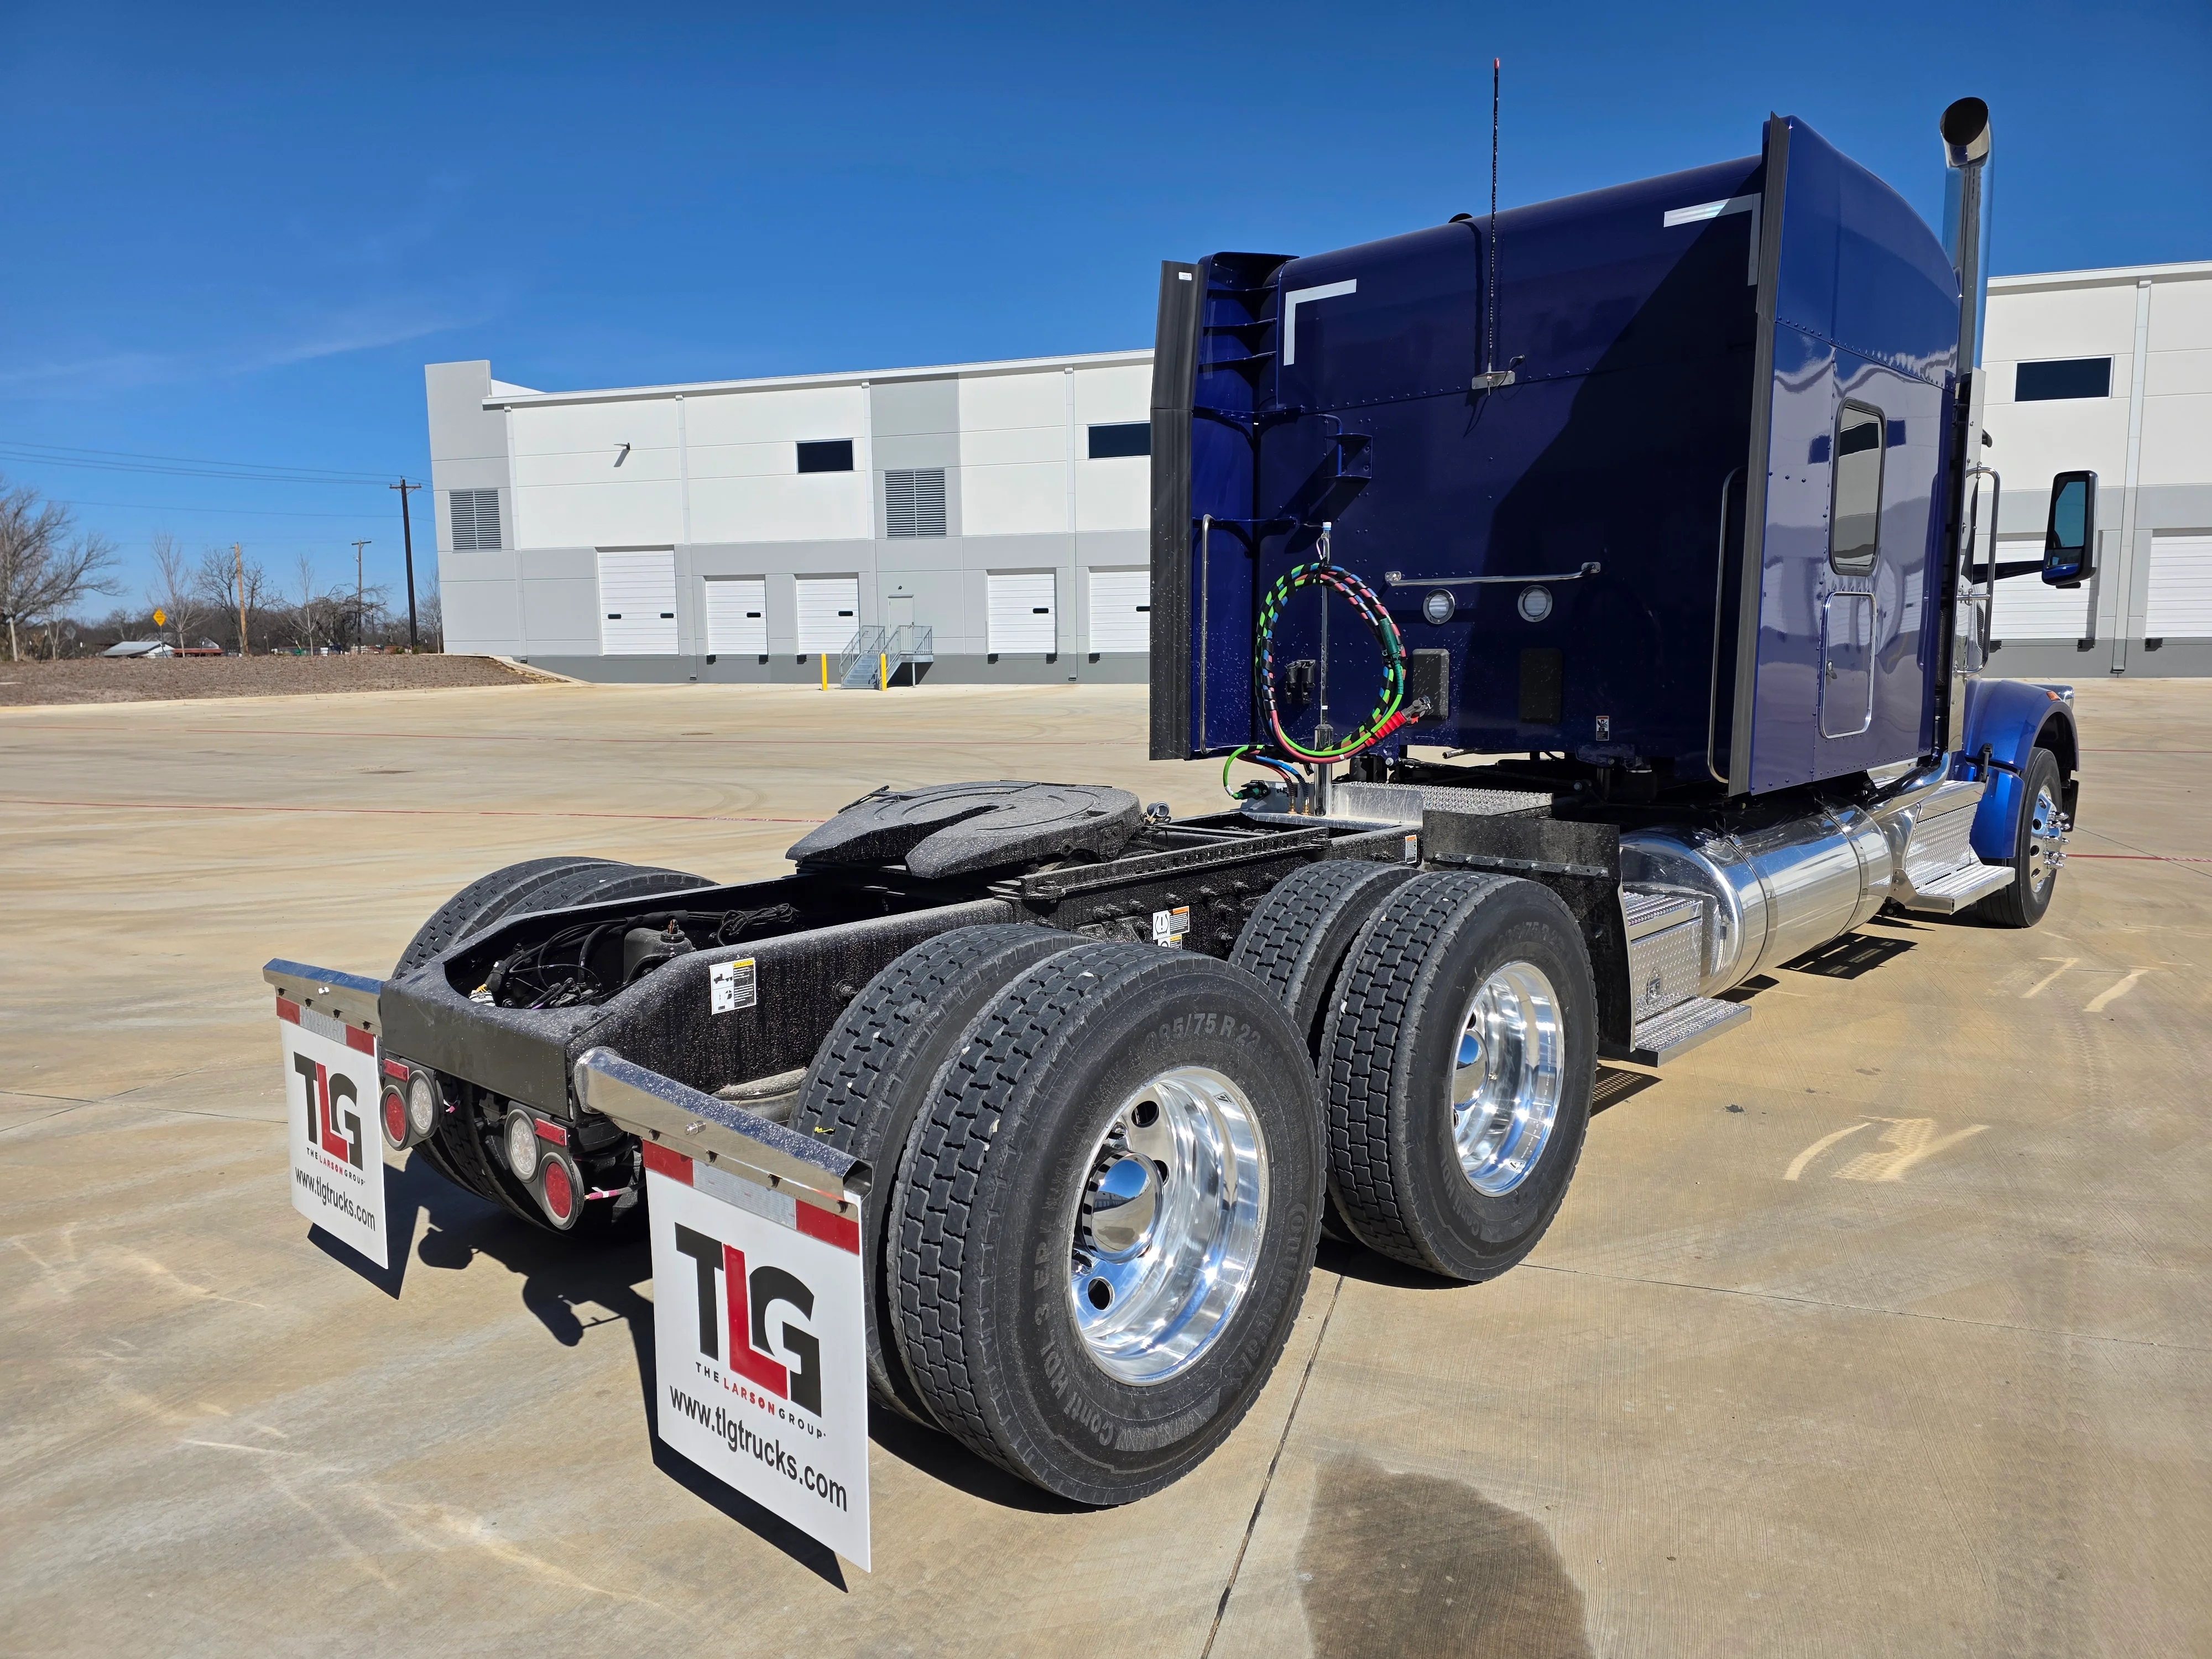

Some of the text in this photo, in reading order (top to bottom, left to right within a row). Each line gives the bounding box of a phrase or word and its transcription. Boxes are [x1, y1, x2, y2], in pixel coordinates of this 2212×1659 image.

[1219, 1015, 1236, 1039] R
[293, 1051, 363, 1171] TLG
[295, 1166, 376, 1232] www.tlgtrucks.com
[306, 1147, 364, 1186] THE LARSON GROUP
[674, 1222, 822, 1418] TLG
[695, 1361, 822, 1439] THE LARSON GROUP
[1063, 1392, 1114, 1446] Conti
[669, 1385, 847, 1512] www.tlgtrucks.com
